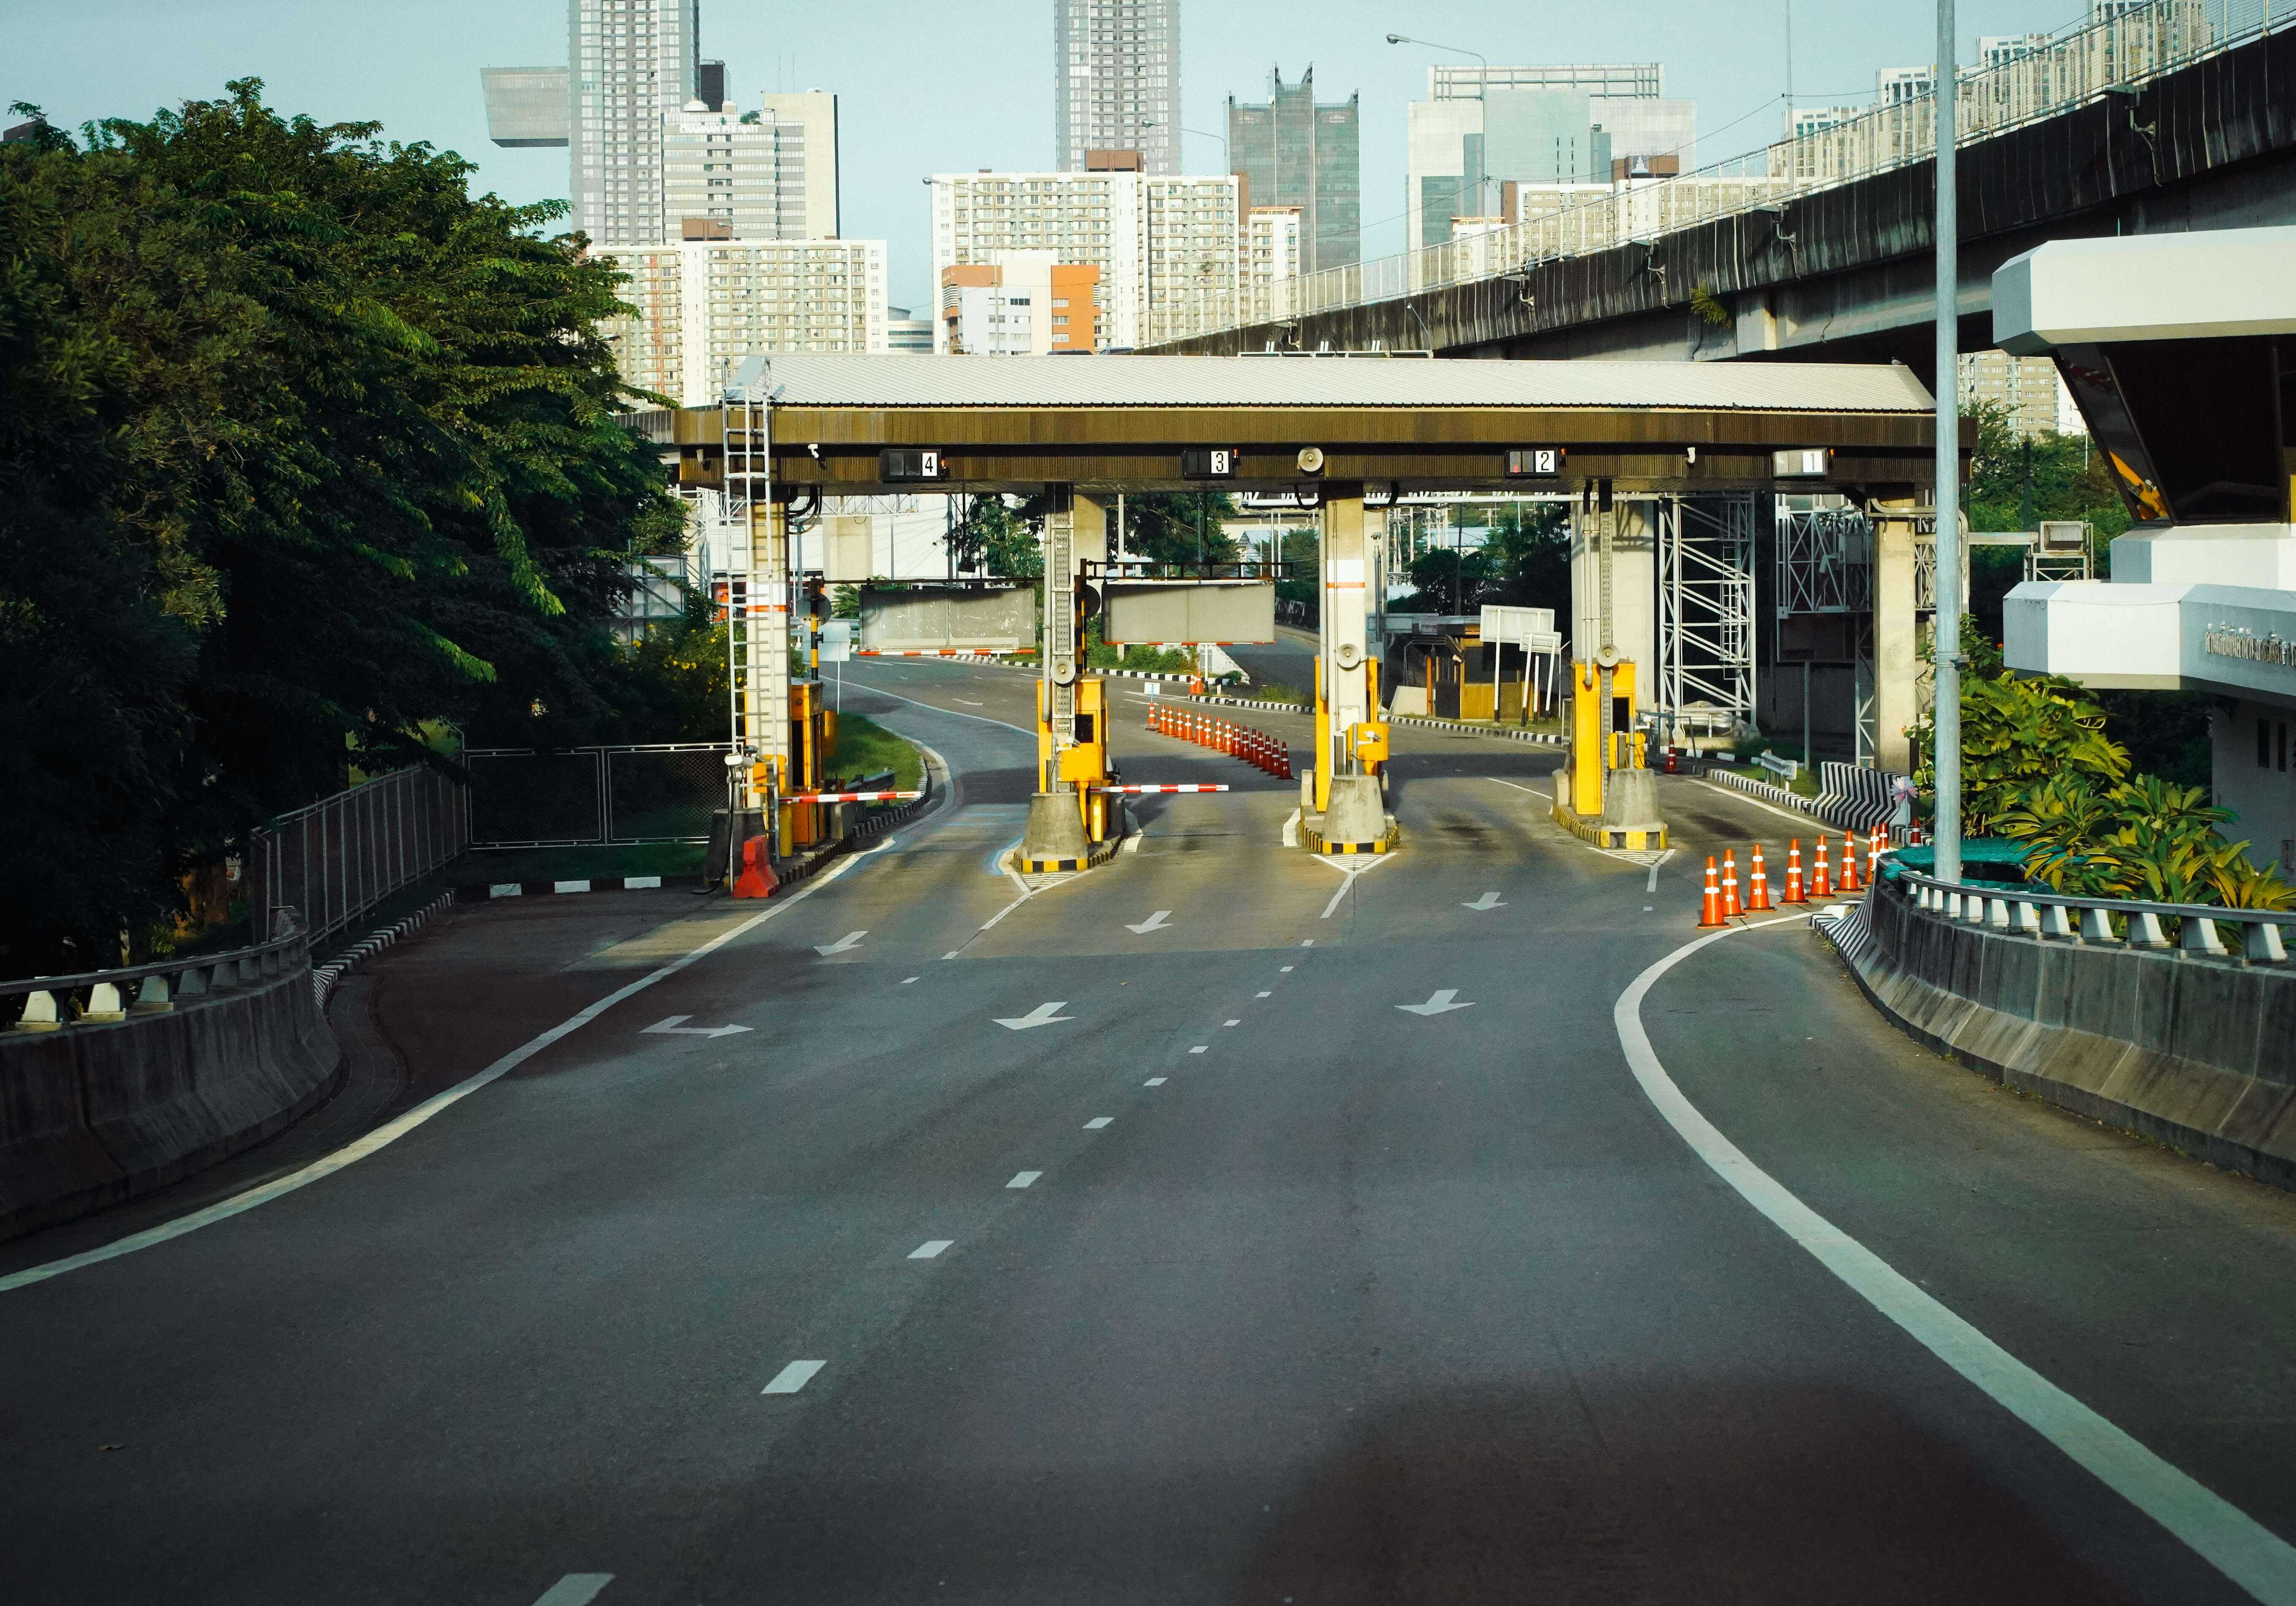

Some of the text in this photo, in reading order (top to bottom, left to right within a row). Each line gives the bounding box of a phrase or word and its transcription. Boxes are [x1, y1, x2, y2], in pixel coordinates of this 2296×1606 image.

[679, 125, 720, 133] CHAMNAN
[925, 456, 933, 472] 4
[1216, 453, 1223, 472] 3
[1541, 452, 1549, 471] 2
[1811, 453, 1815, 471] 1
